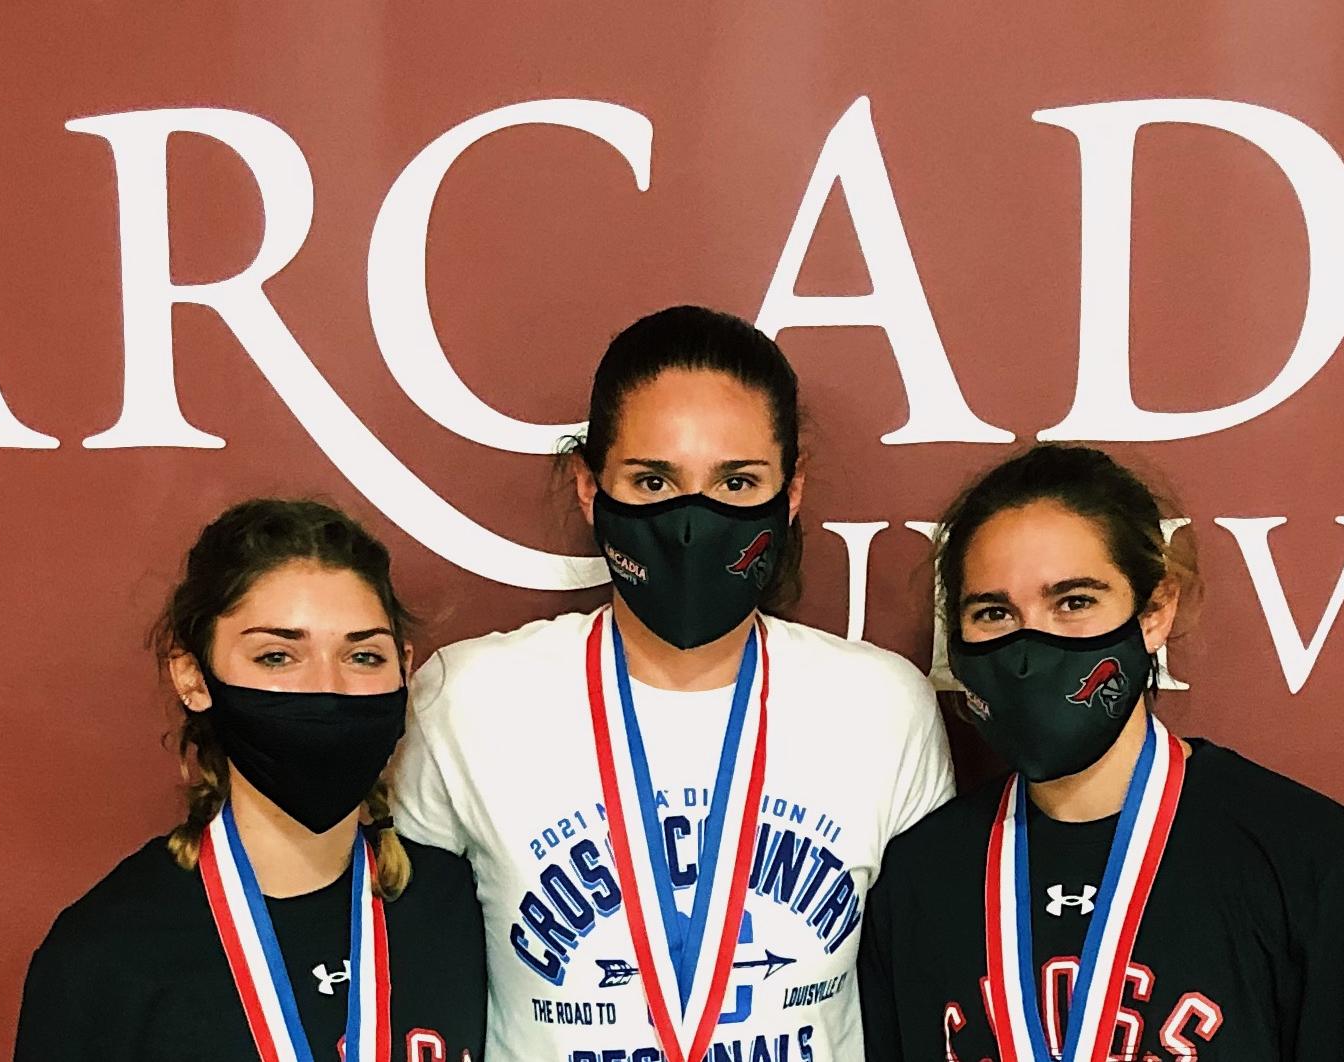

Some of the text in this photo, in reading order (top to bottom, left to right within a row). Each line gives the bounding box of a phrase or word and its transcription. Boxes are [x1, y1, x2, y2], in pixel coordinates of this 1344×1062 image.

[530, 809, 588, 861] 2021
[805, 813, 842, 844] III
[509, 832, 623, 987] CROS
[532, 998, 554, 1024] THE
[557, 1001, 593, 1025] ROAD
[596, 1002, 617, 1026] TO
